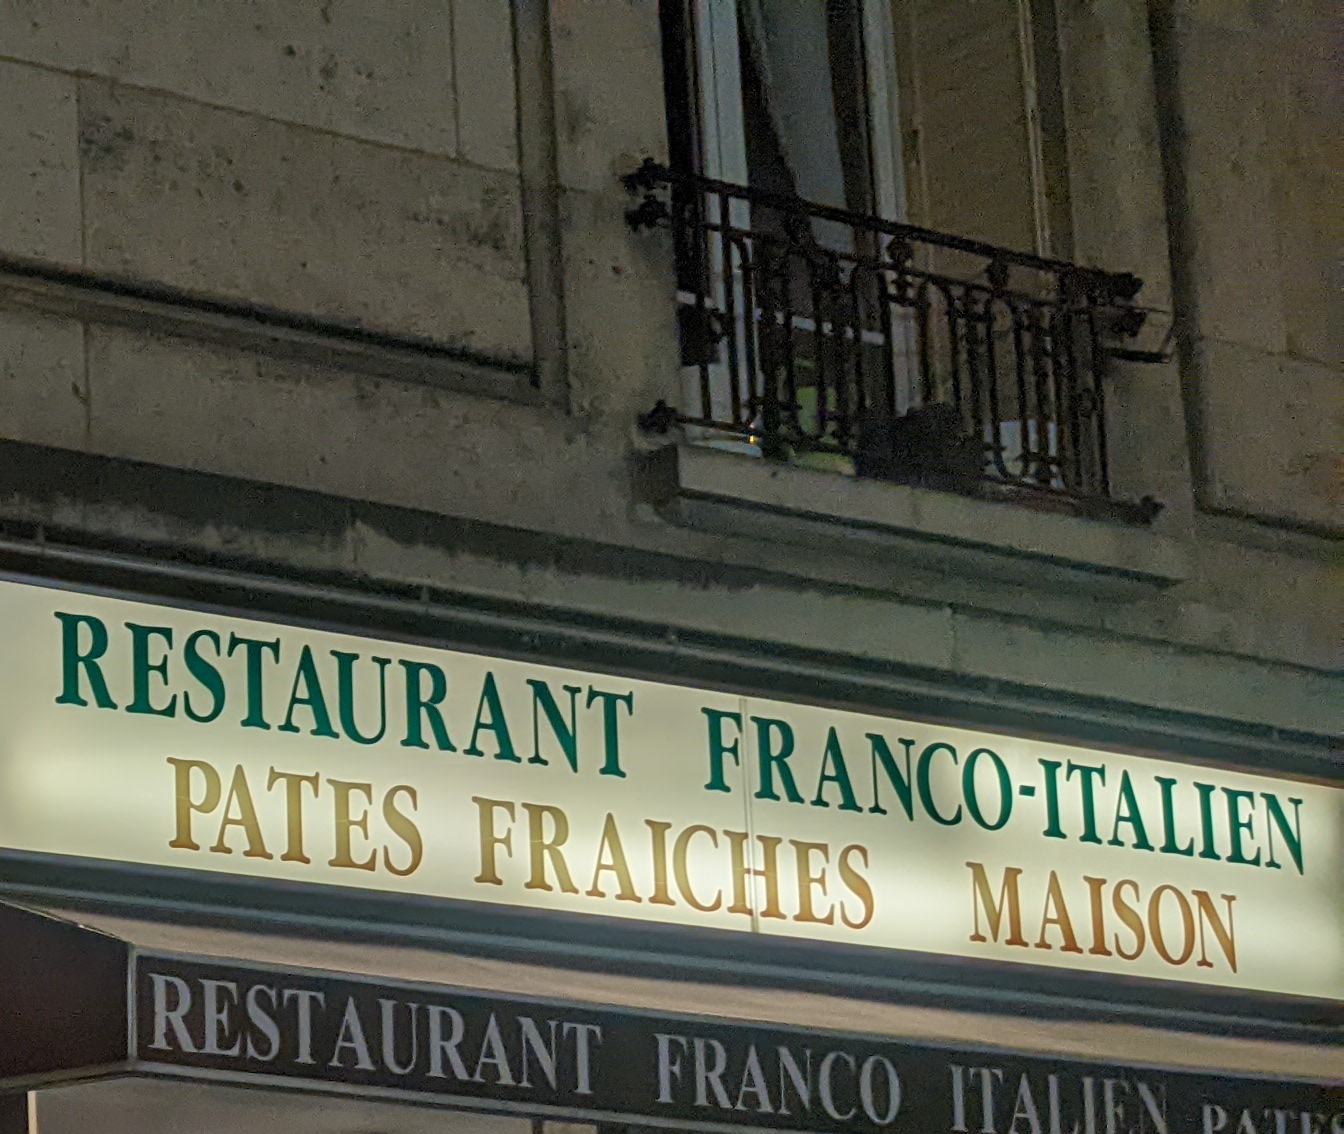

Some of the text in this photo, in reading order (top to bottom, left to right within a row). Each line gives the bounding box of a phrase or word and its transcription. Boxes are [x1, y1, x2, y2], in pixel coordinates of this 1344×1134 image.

[54, 611, 1305, 875] RESTAURANT FRANCO-ITALIEN
[166, 756, 1238, 974] PATES FRAICHES MAISON
[148, 972, 601, 1095] RESTAURANT
[654, 1032, 901, 1126] FRANCO
